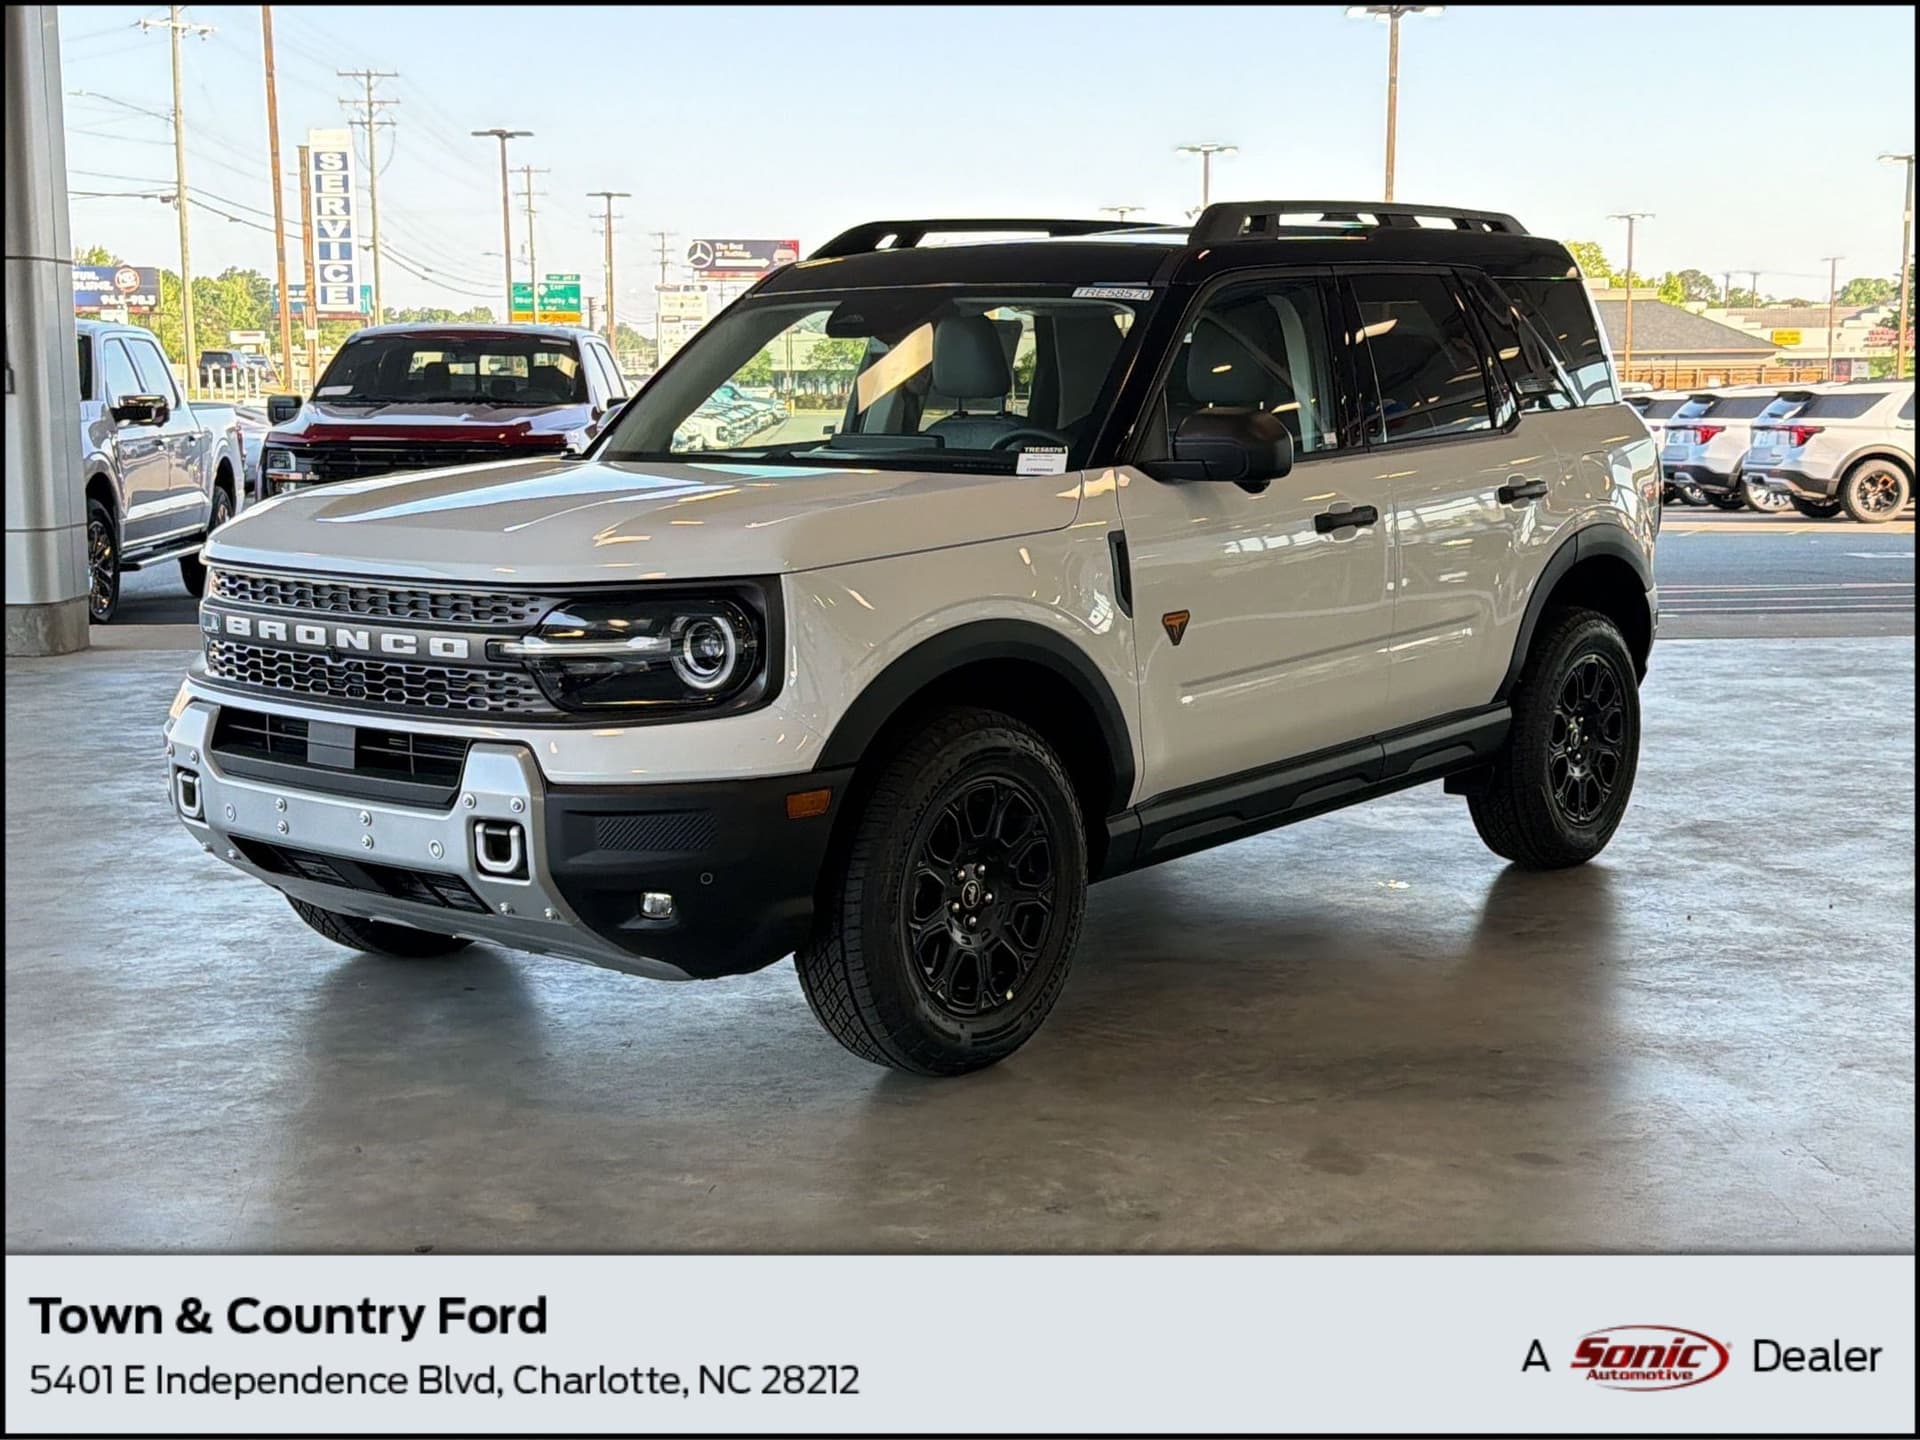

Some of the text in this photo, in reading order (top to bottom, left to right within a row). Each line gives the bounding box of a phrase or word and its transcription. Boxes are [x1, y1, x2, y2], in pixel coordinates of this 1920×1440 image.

[318, 153, 352, 305] SERVICE
[1077, 287, 1151, 300] TRE58570
[225, 615, 470, 660] BRONCO
